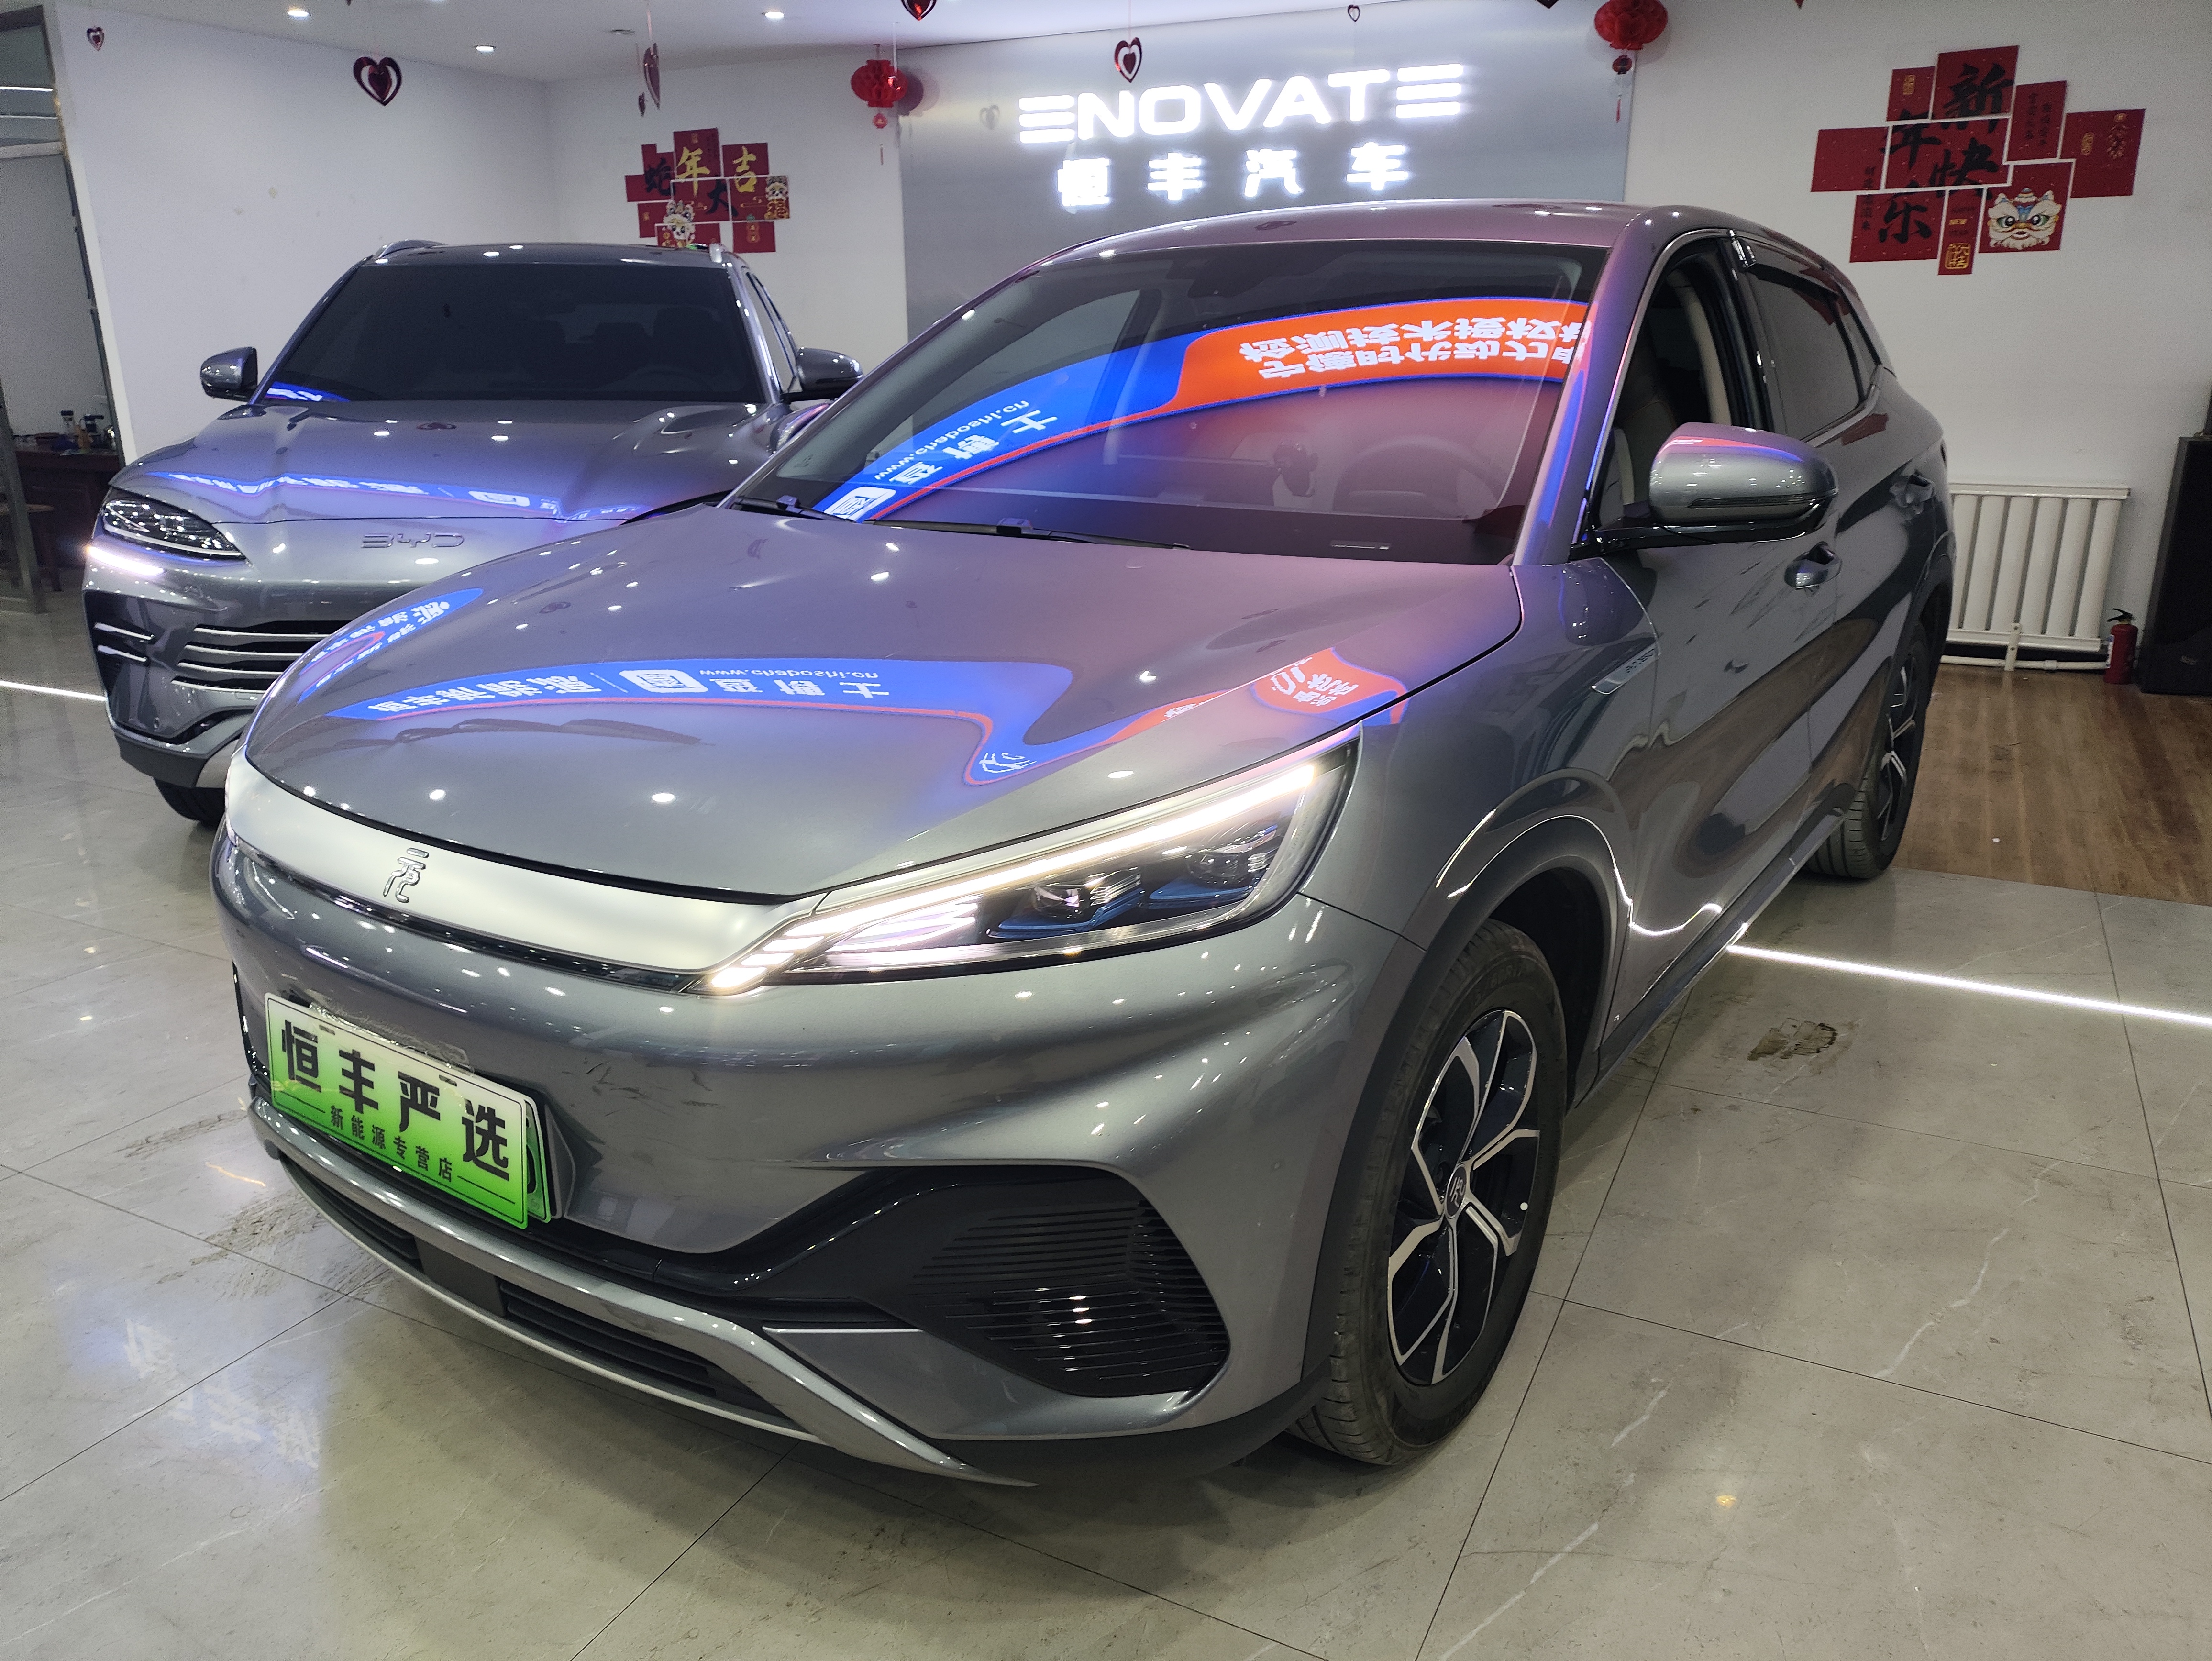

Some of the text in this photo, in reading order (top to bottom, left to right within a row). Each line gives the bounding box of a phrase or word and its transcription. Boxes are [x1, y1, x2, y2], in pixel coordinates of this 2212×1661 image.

[1019, 63, 1463, 144] ENOVATE
[1057, 142, 1408, 206] 恒丰汽车
[361, 532, 464, 548] BYD
[281, 1019, 509, 1182] 恒丰严选
[330, 1105, 453, 1183] 新能源专营店
